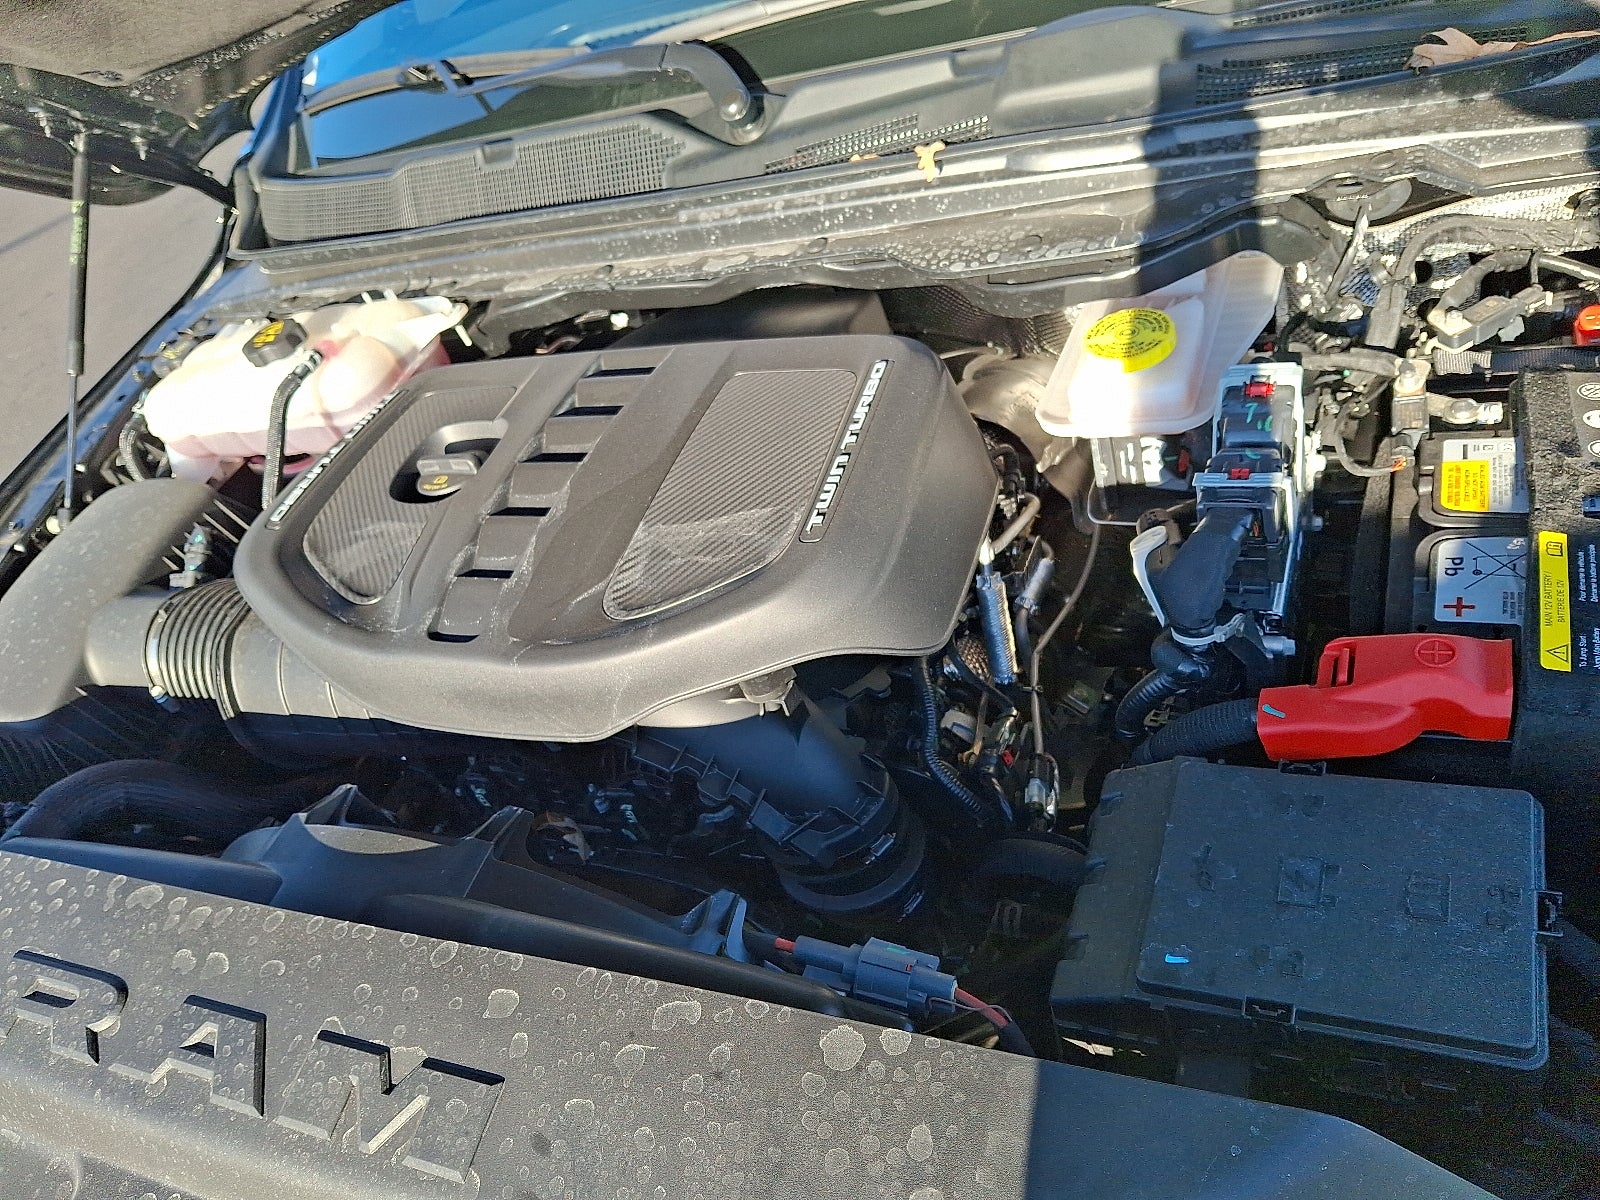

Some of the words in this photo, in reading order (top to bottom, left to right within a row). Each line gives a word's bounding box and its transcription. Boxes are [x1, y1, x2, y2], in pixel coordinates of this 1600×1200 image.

[805, 455, 850, 534] TWIN
[840, 361, 889, 451] TURBO
[269, 442, 348, 522] TURBO
[1444, 556, 1465, 577] Pb
[1543, 575, 1552, 599] BATTERY
[1556, 579, 1564, 589] 12V
[1557, 589, 1565, 598] DE
[1544, 600, 1553, 611] 12V
[1557, 598, 1566, 623] BATTERIE
[1544, 612, 1553, 627] MAIN
[1579, 647, 1588, 661] Jump
[0, 948, 506, 1184] RAM
